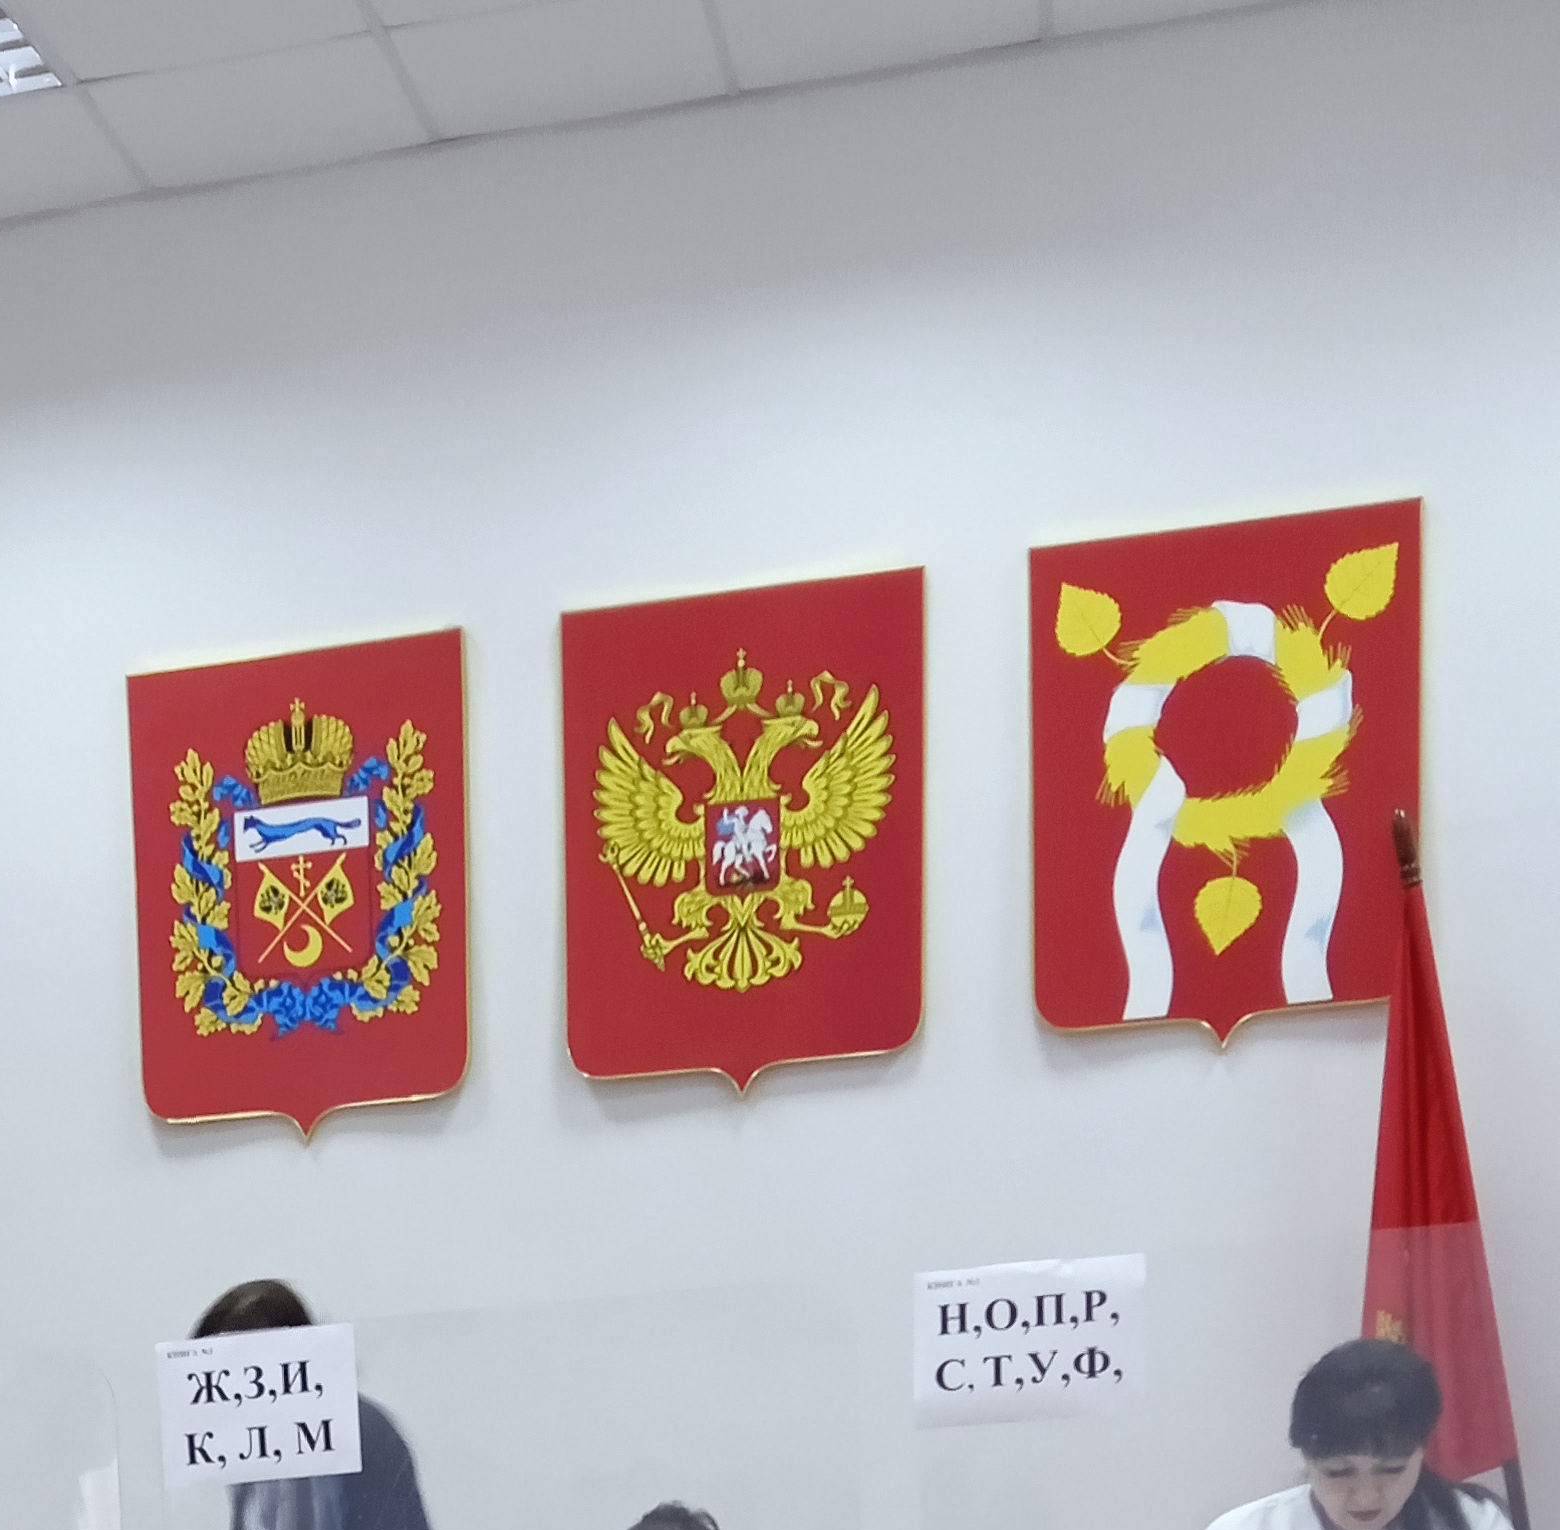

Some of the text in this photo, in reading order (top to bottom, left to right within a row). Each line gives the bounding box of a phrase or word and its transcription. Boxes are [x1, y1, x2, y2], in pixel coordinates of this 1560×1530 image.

[184, 1418, 336, 1469] К, Л, М
